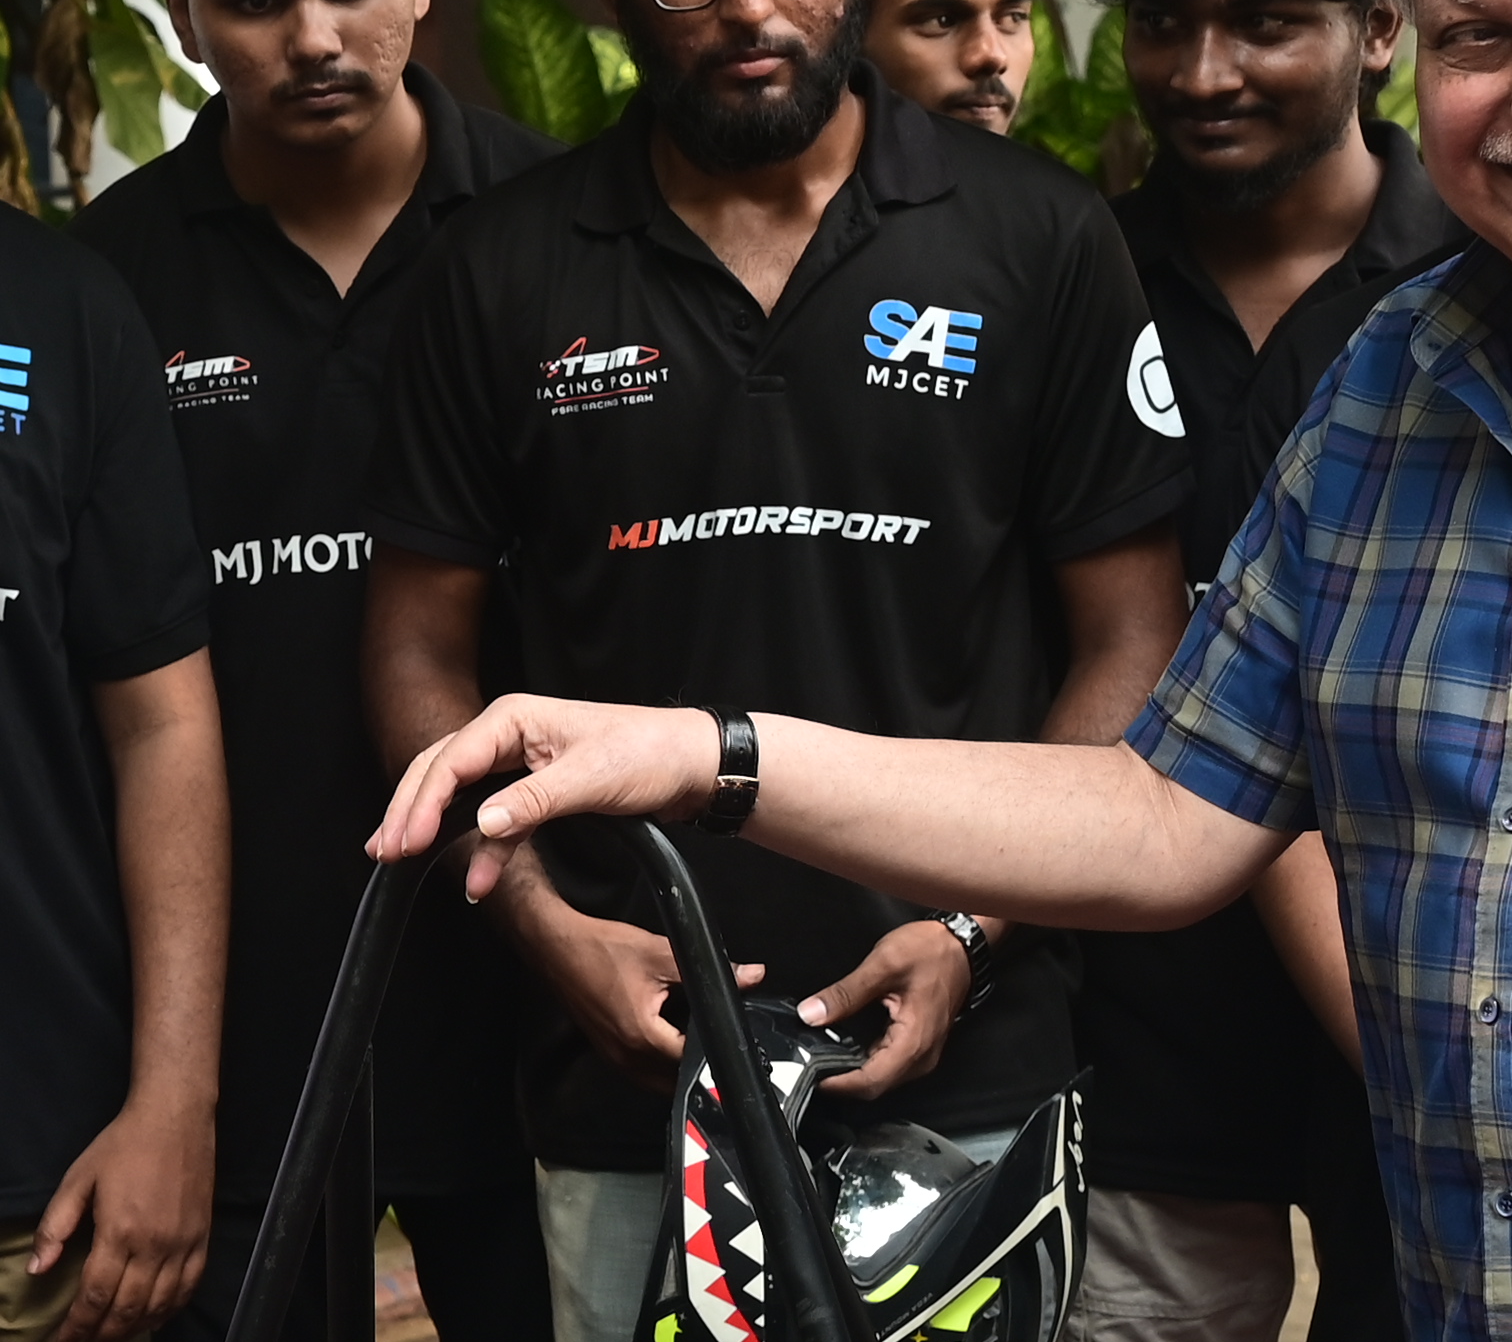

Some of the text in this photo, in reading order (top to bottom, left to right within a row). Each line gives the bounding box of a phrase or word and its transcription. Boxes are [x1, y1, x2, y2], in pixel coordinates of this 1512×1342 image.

[864, 299, 983, 374] SAE
[866, 364, 970, 400] MJCET
[211, 531, 373, 585] MJ MOT
